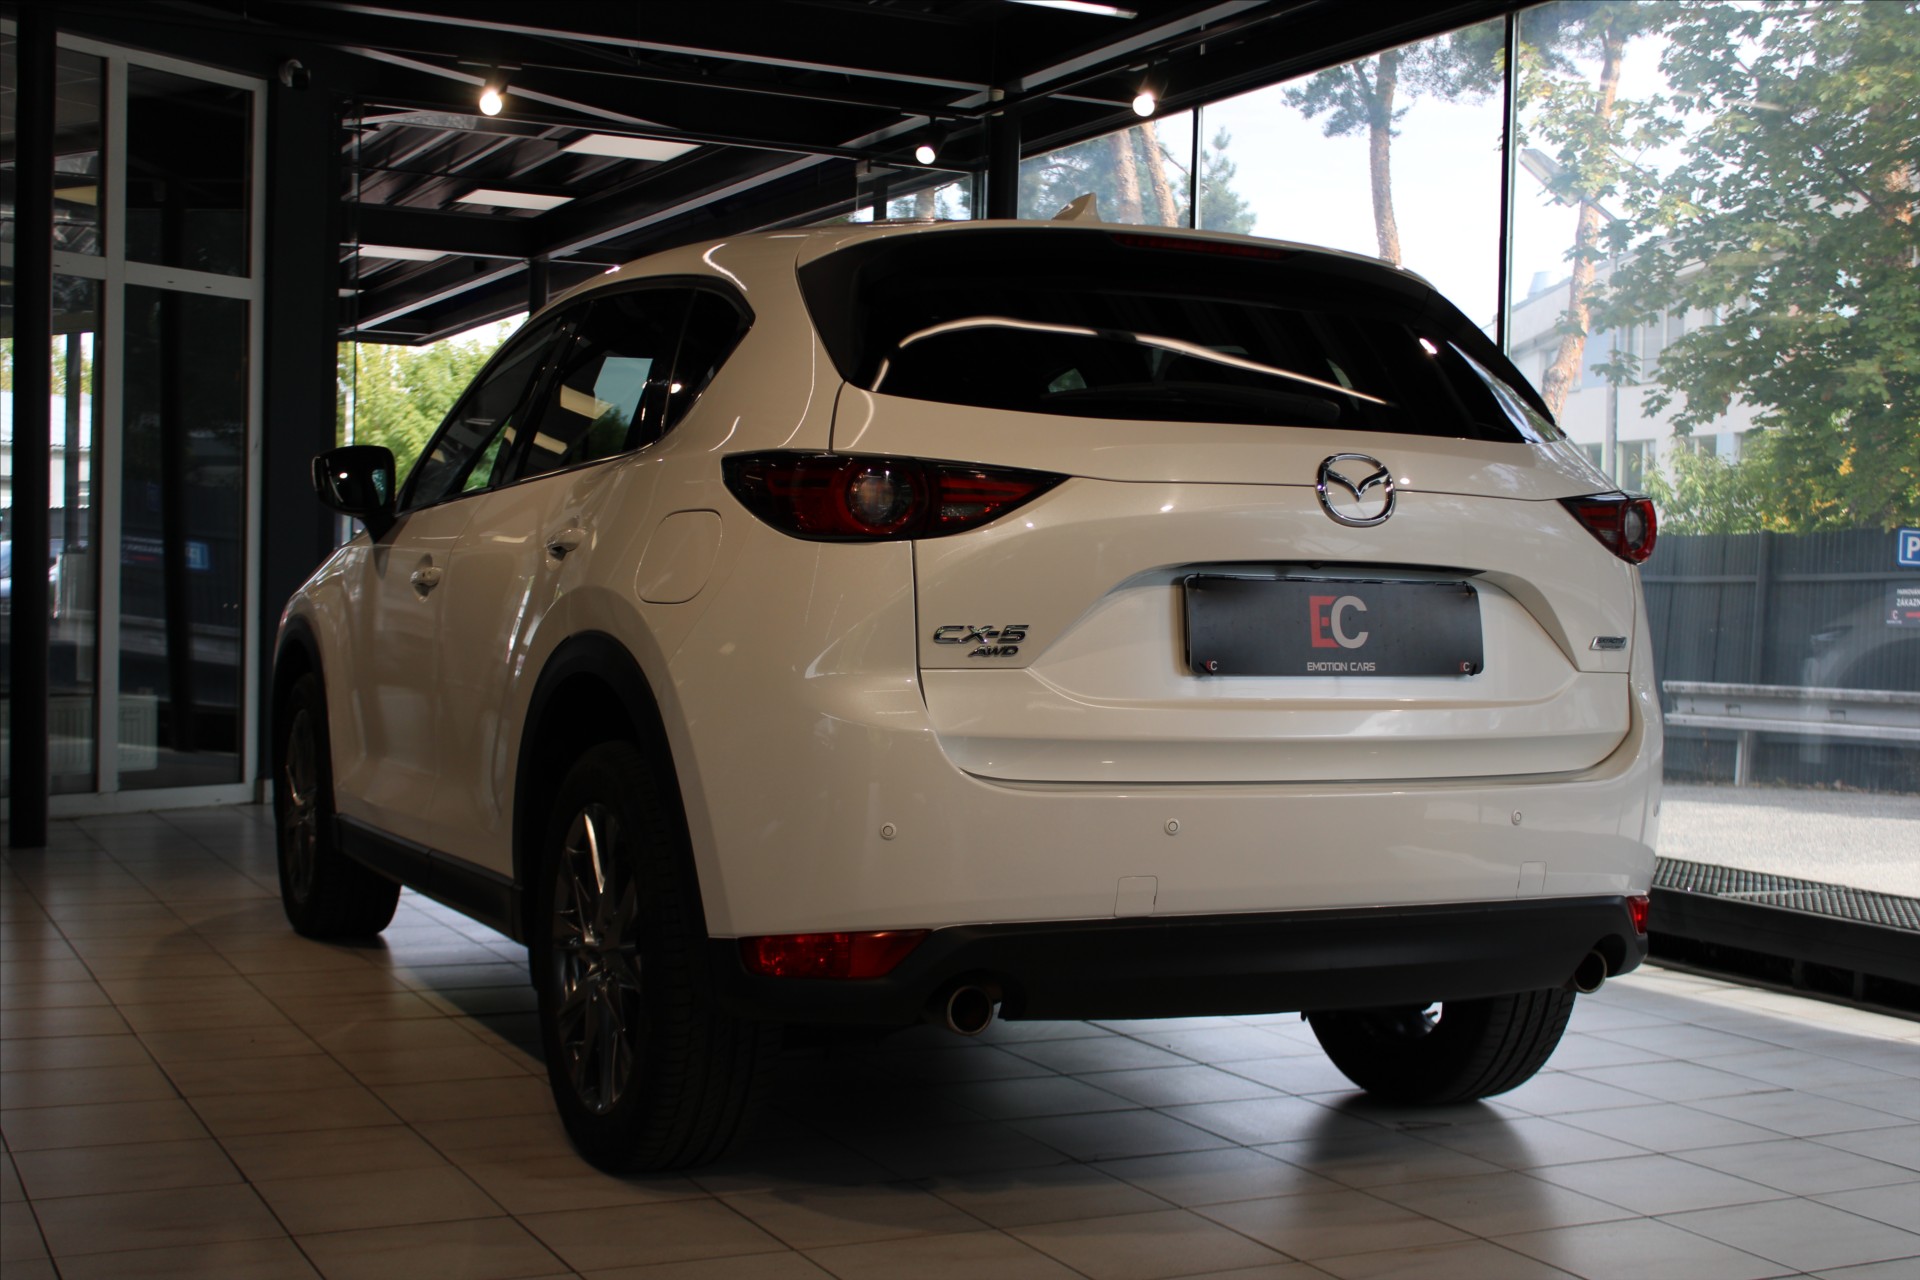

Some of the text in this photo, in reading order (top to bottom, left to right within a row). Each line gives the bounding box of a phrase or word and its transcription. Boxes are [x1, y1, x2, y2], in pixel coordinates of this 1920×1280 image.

[1906, 536, 1920, 559] P
[1309, 595, 1369, 649] EC
[933, 624, 1029, 645] CX-5
[967, 645, 1019, 658] AWD
[1307, 661, 1376, 671] EMOTION CARS
